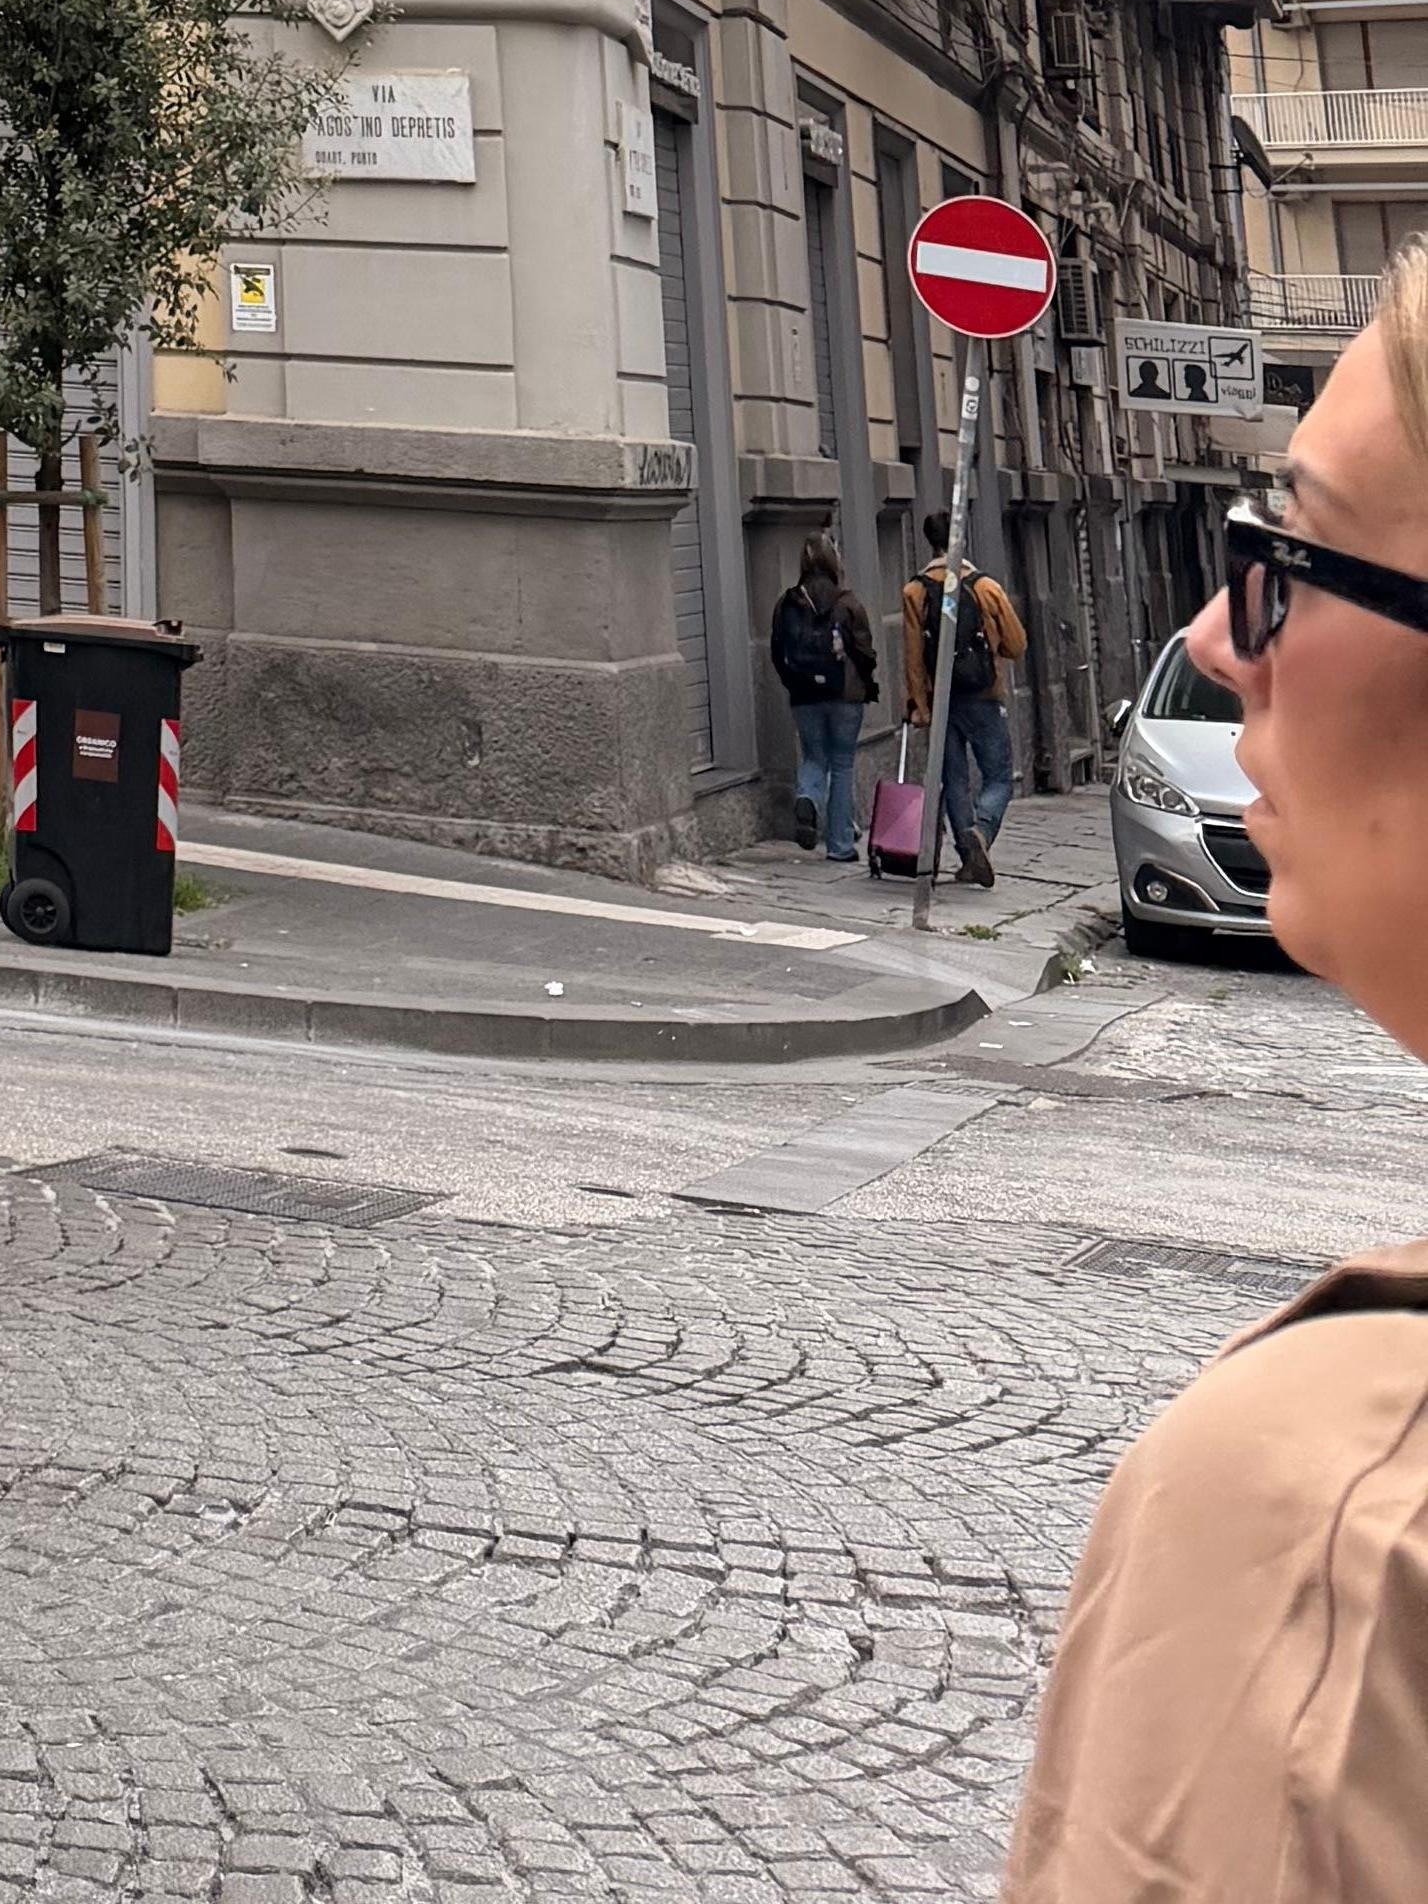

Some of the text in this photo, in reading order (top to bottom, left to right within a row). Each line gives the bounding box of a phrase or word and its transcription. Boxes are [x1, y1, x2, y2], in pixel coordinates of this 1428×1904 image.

[371, 85, 397, 104] VIA
[391, 115, 456, 139] DEPRETIS
[350, 151, 378, 166] PORTO
[1124, 336, 1206, 355] SCHILIZZI
